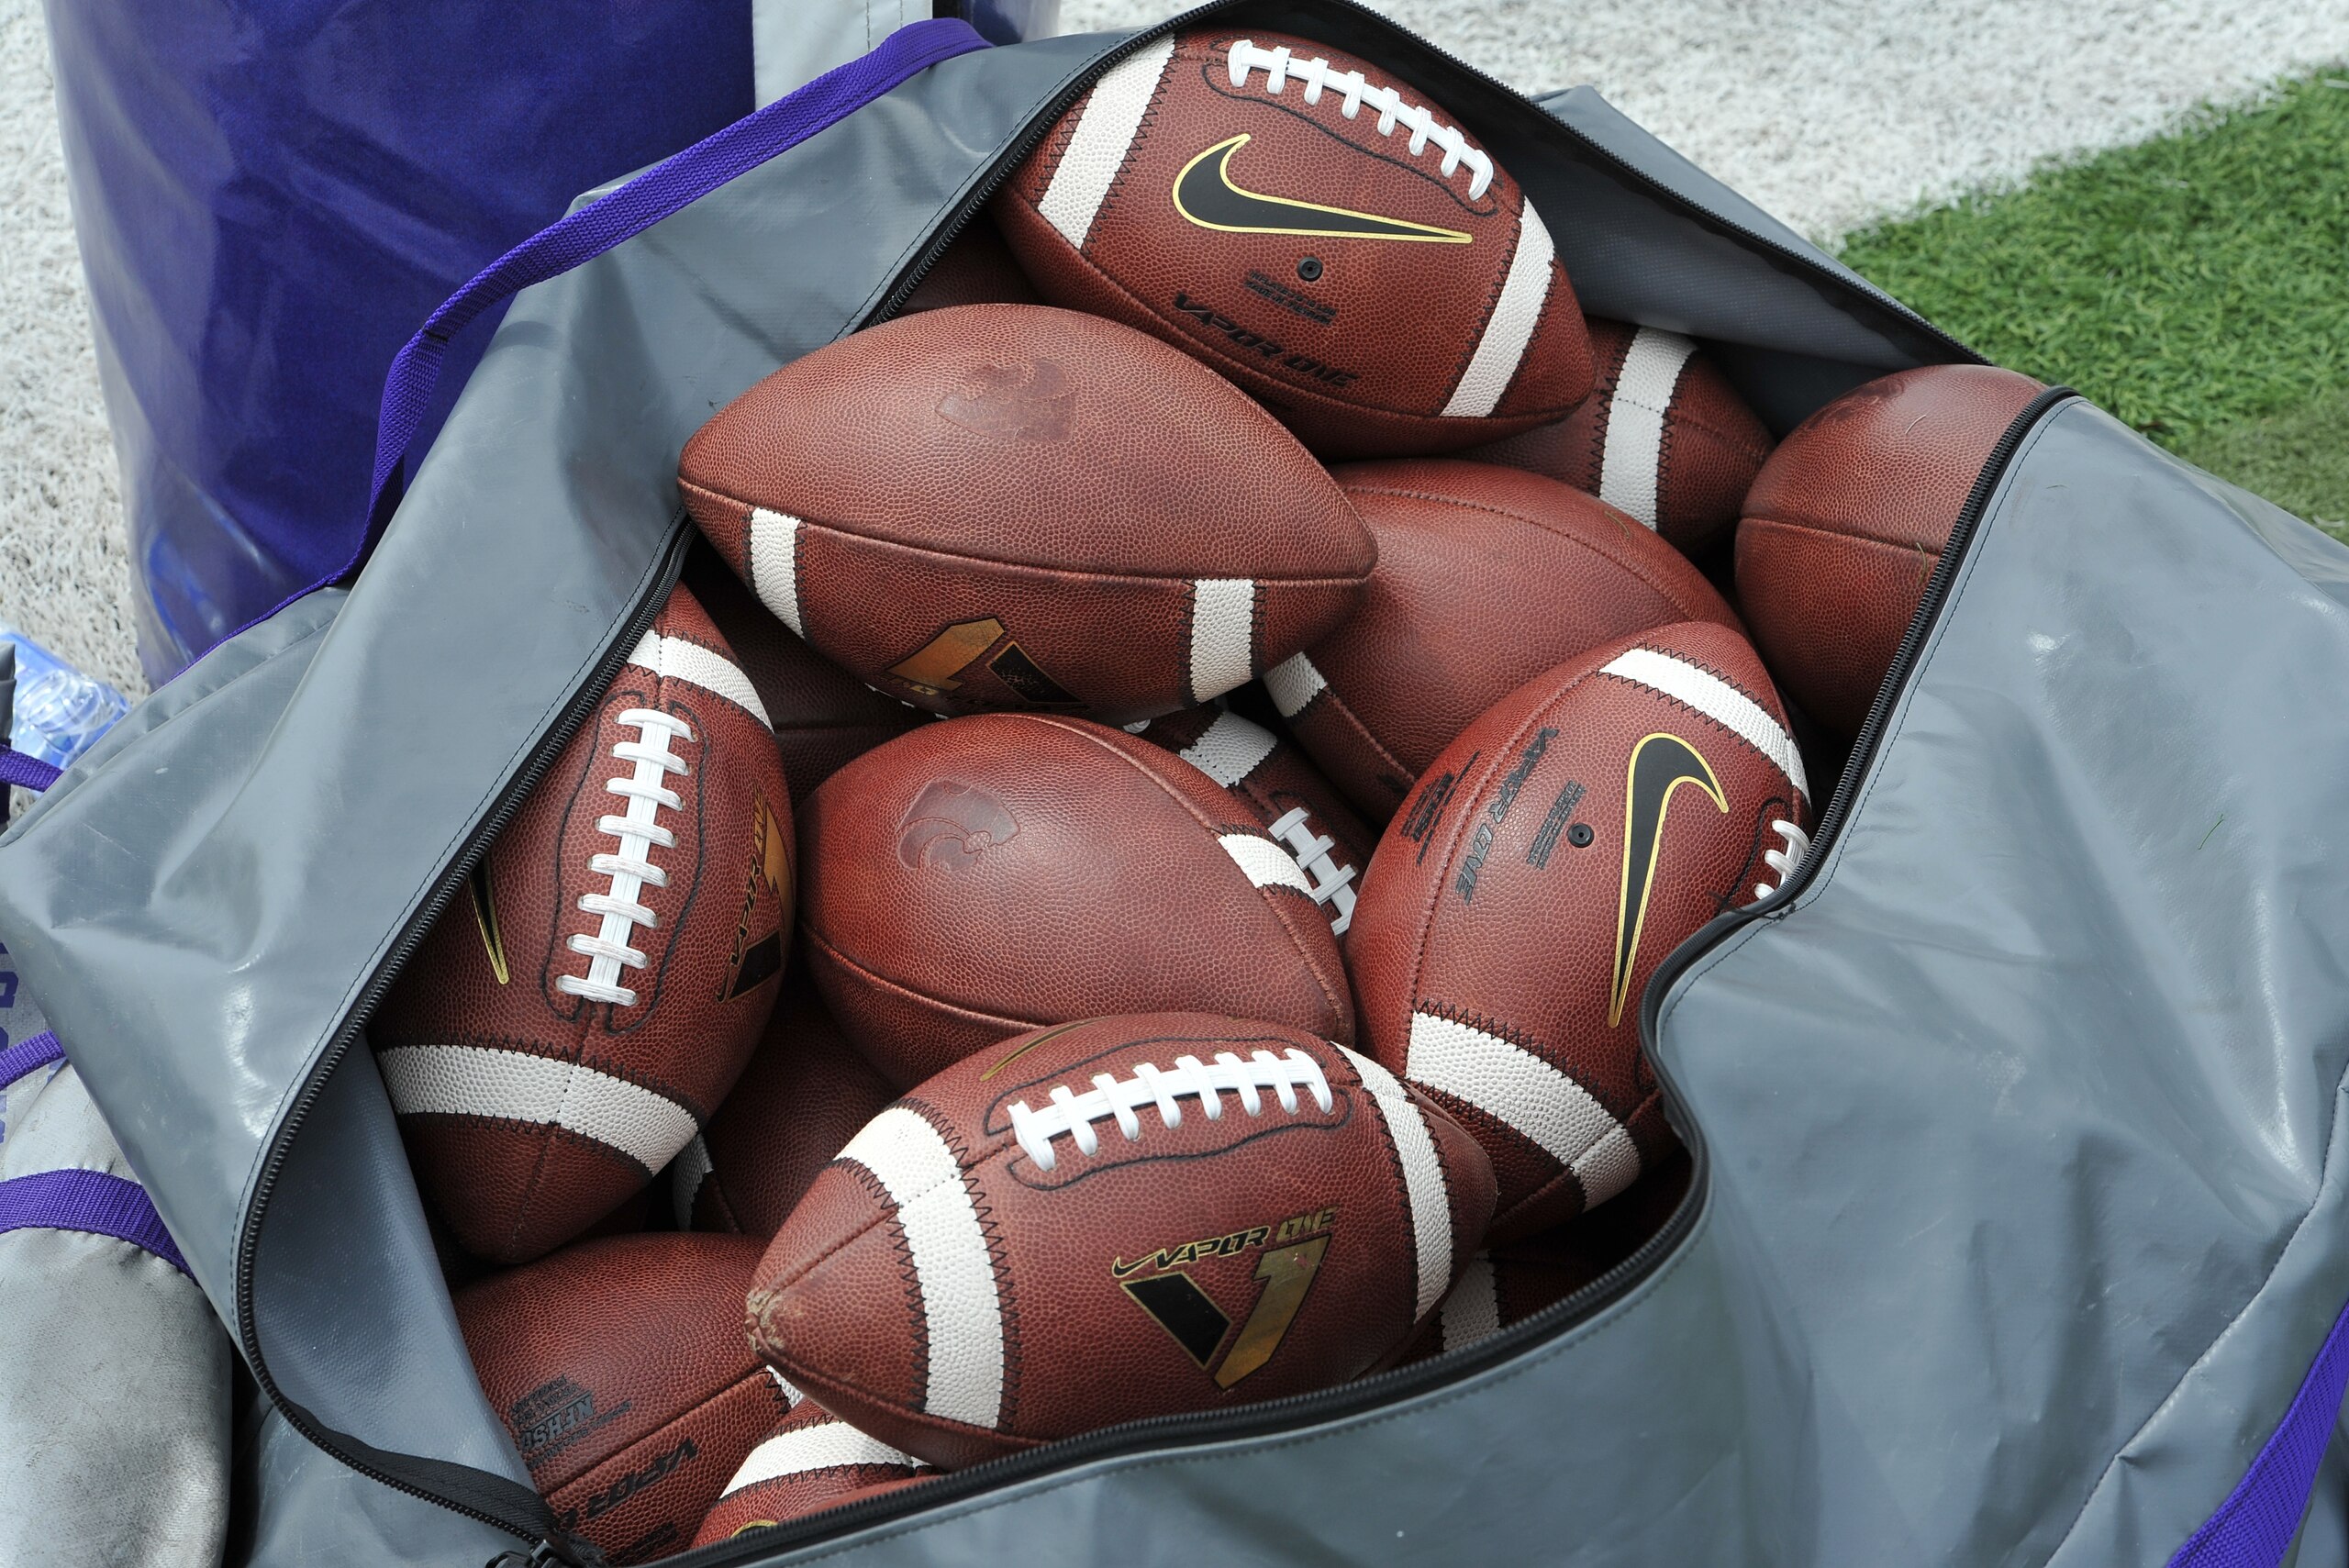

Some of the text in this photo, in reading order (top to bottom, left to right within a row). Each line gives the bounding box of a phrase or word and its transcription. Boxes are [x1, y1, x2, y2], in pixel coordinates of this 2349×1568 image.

[1174, 291, 1360, 387] VAPOR ONE
[1487, 728, 1559, 824] VAPOR
[1455, 823, 1494, 906] ONE
[1155, 1204, 1341, 1270] VAPOR ONE
[586, 1438, 699, 1518] VAPOR
